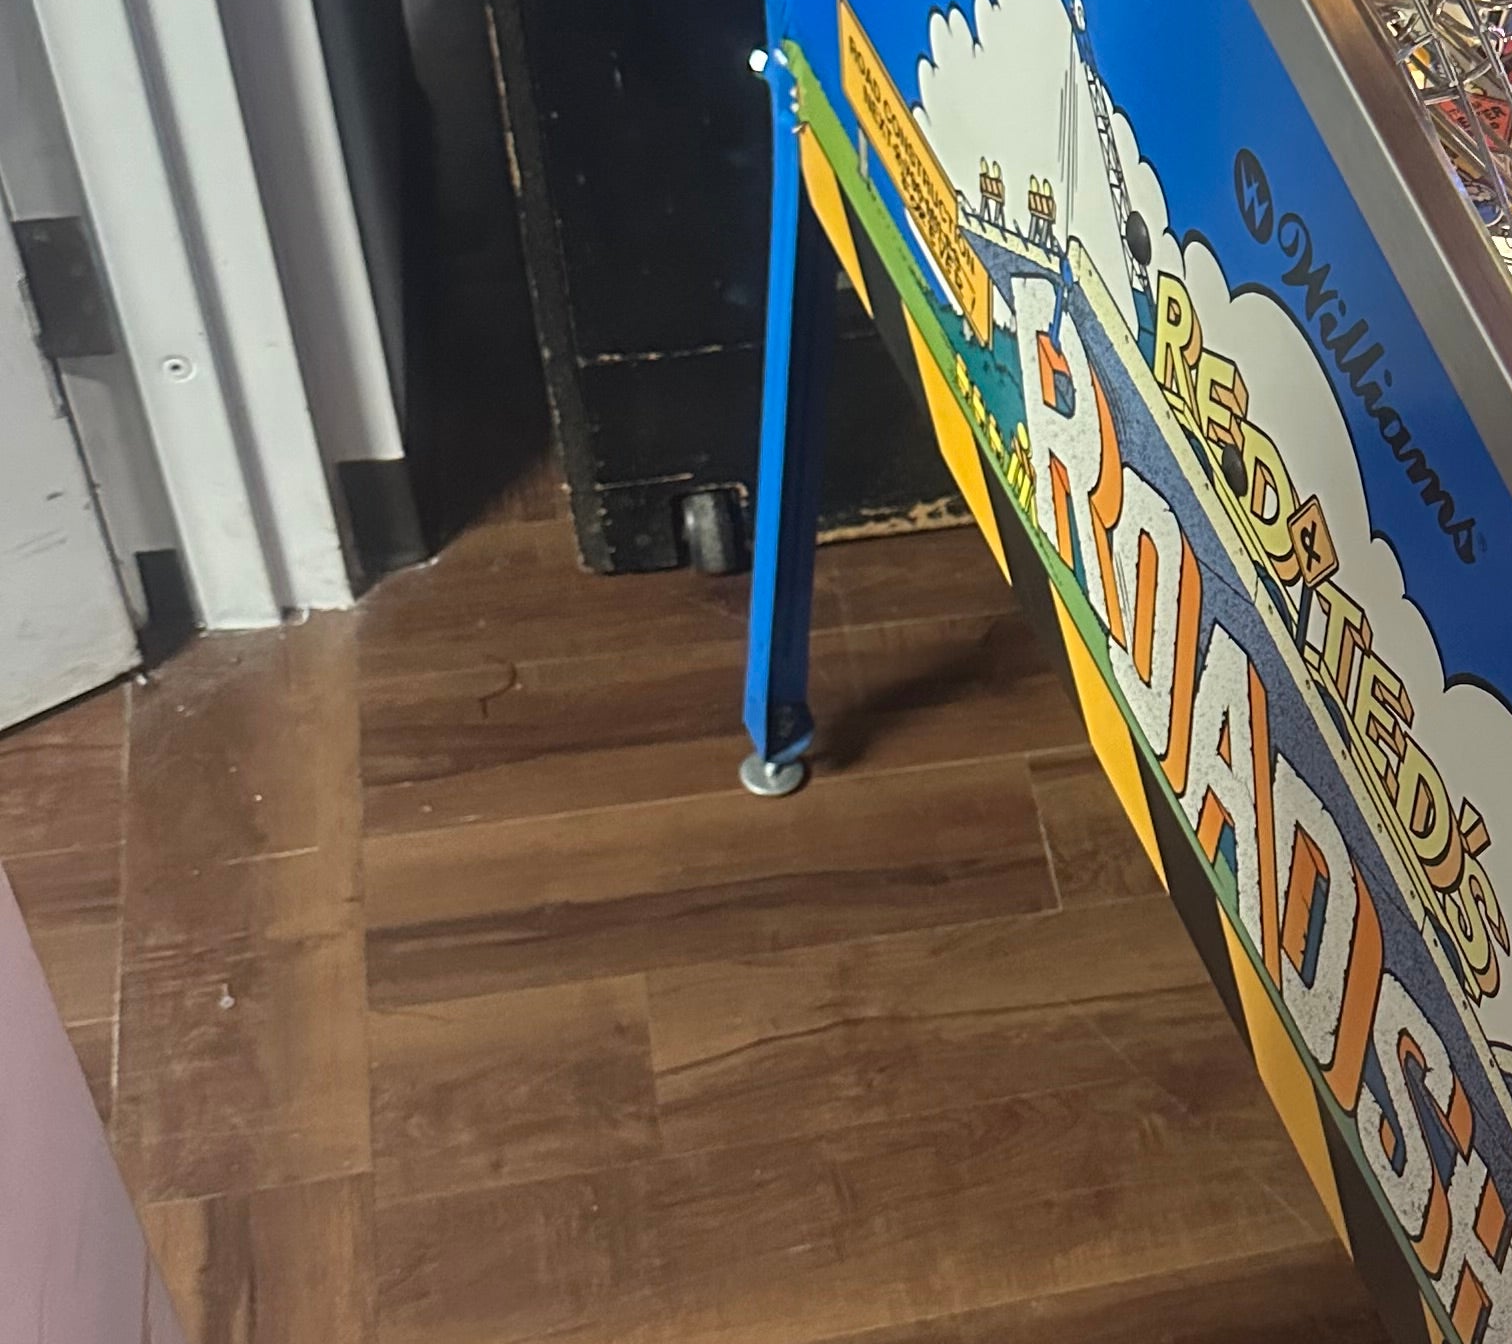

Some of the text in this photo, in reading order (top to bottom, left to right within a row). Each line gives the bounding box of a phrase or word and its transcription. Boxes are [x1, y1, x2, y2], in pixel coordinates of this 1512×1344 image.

[1154, 271, 1302, 588] RED
[1278, 212, 1476, 565] Williams
[1008, 272, 1387, 1108] ROAD
